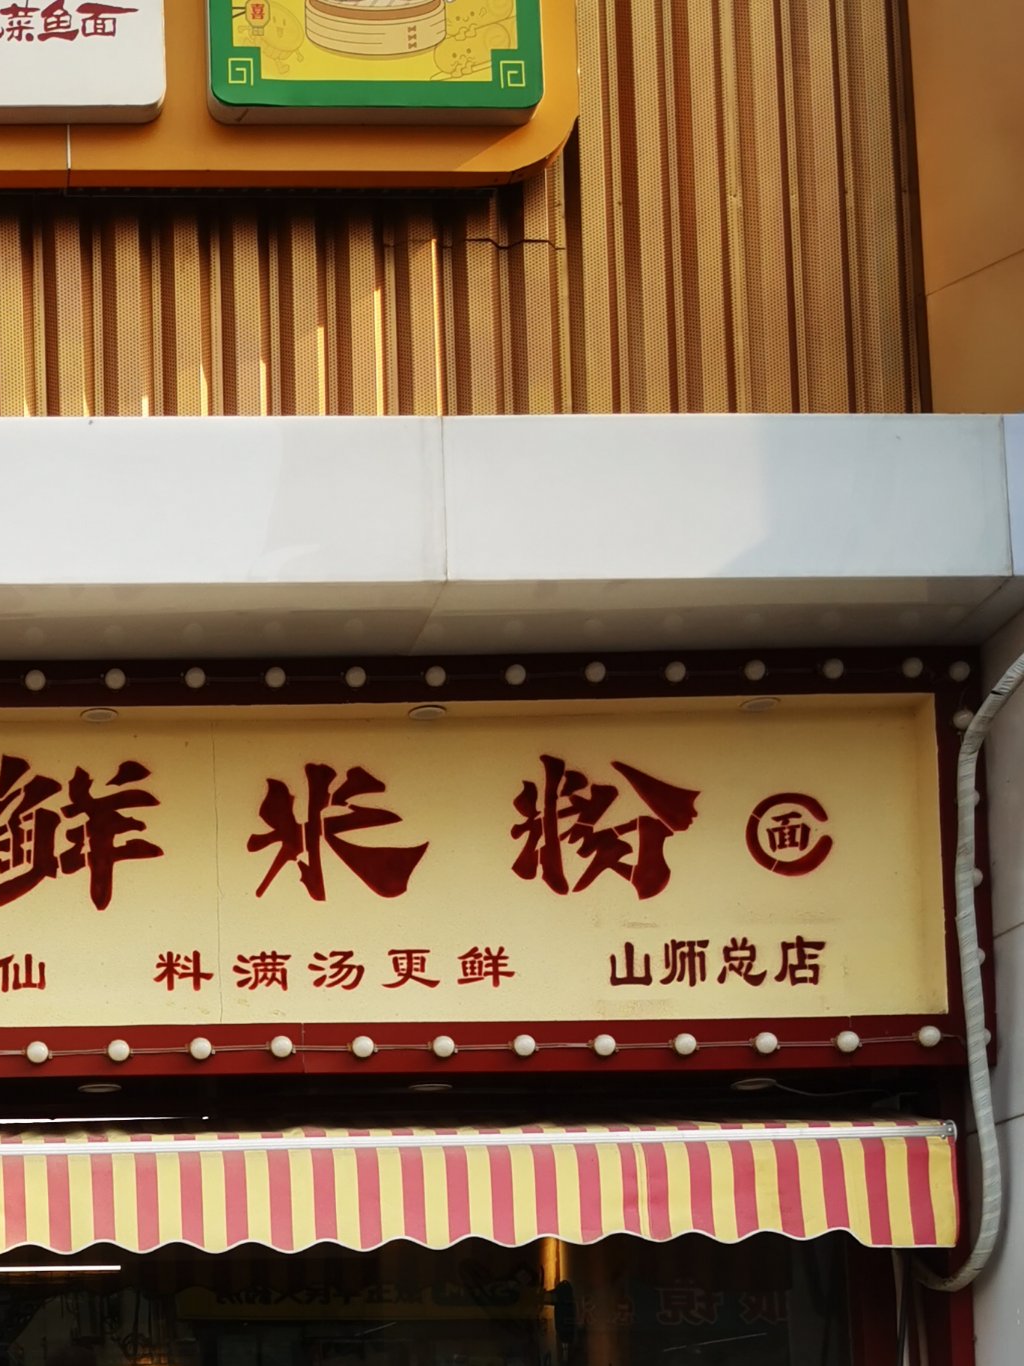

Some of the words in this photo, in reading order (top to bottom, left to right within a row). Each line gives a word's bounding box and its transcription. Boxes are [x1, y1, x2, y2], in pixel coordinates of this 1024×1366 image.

[766, 811, 810, 852] 面
[154, 946, 516, 991] 料满汤更鲜
[610, 936, 826, 987] 山师总店
